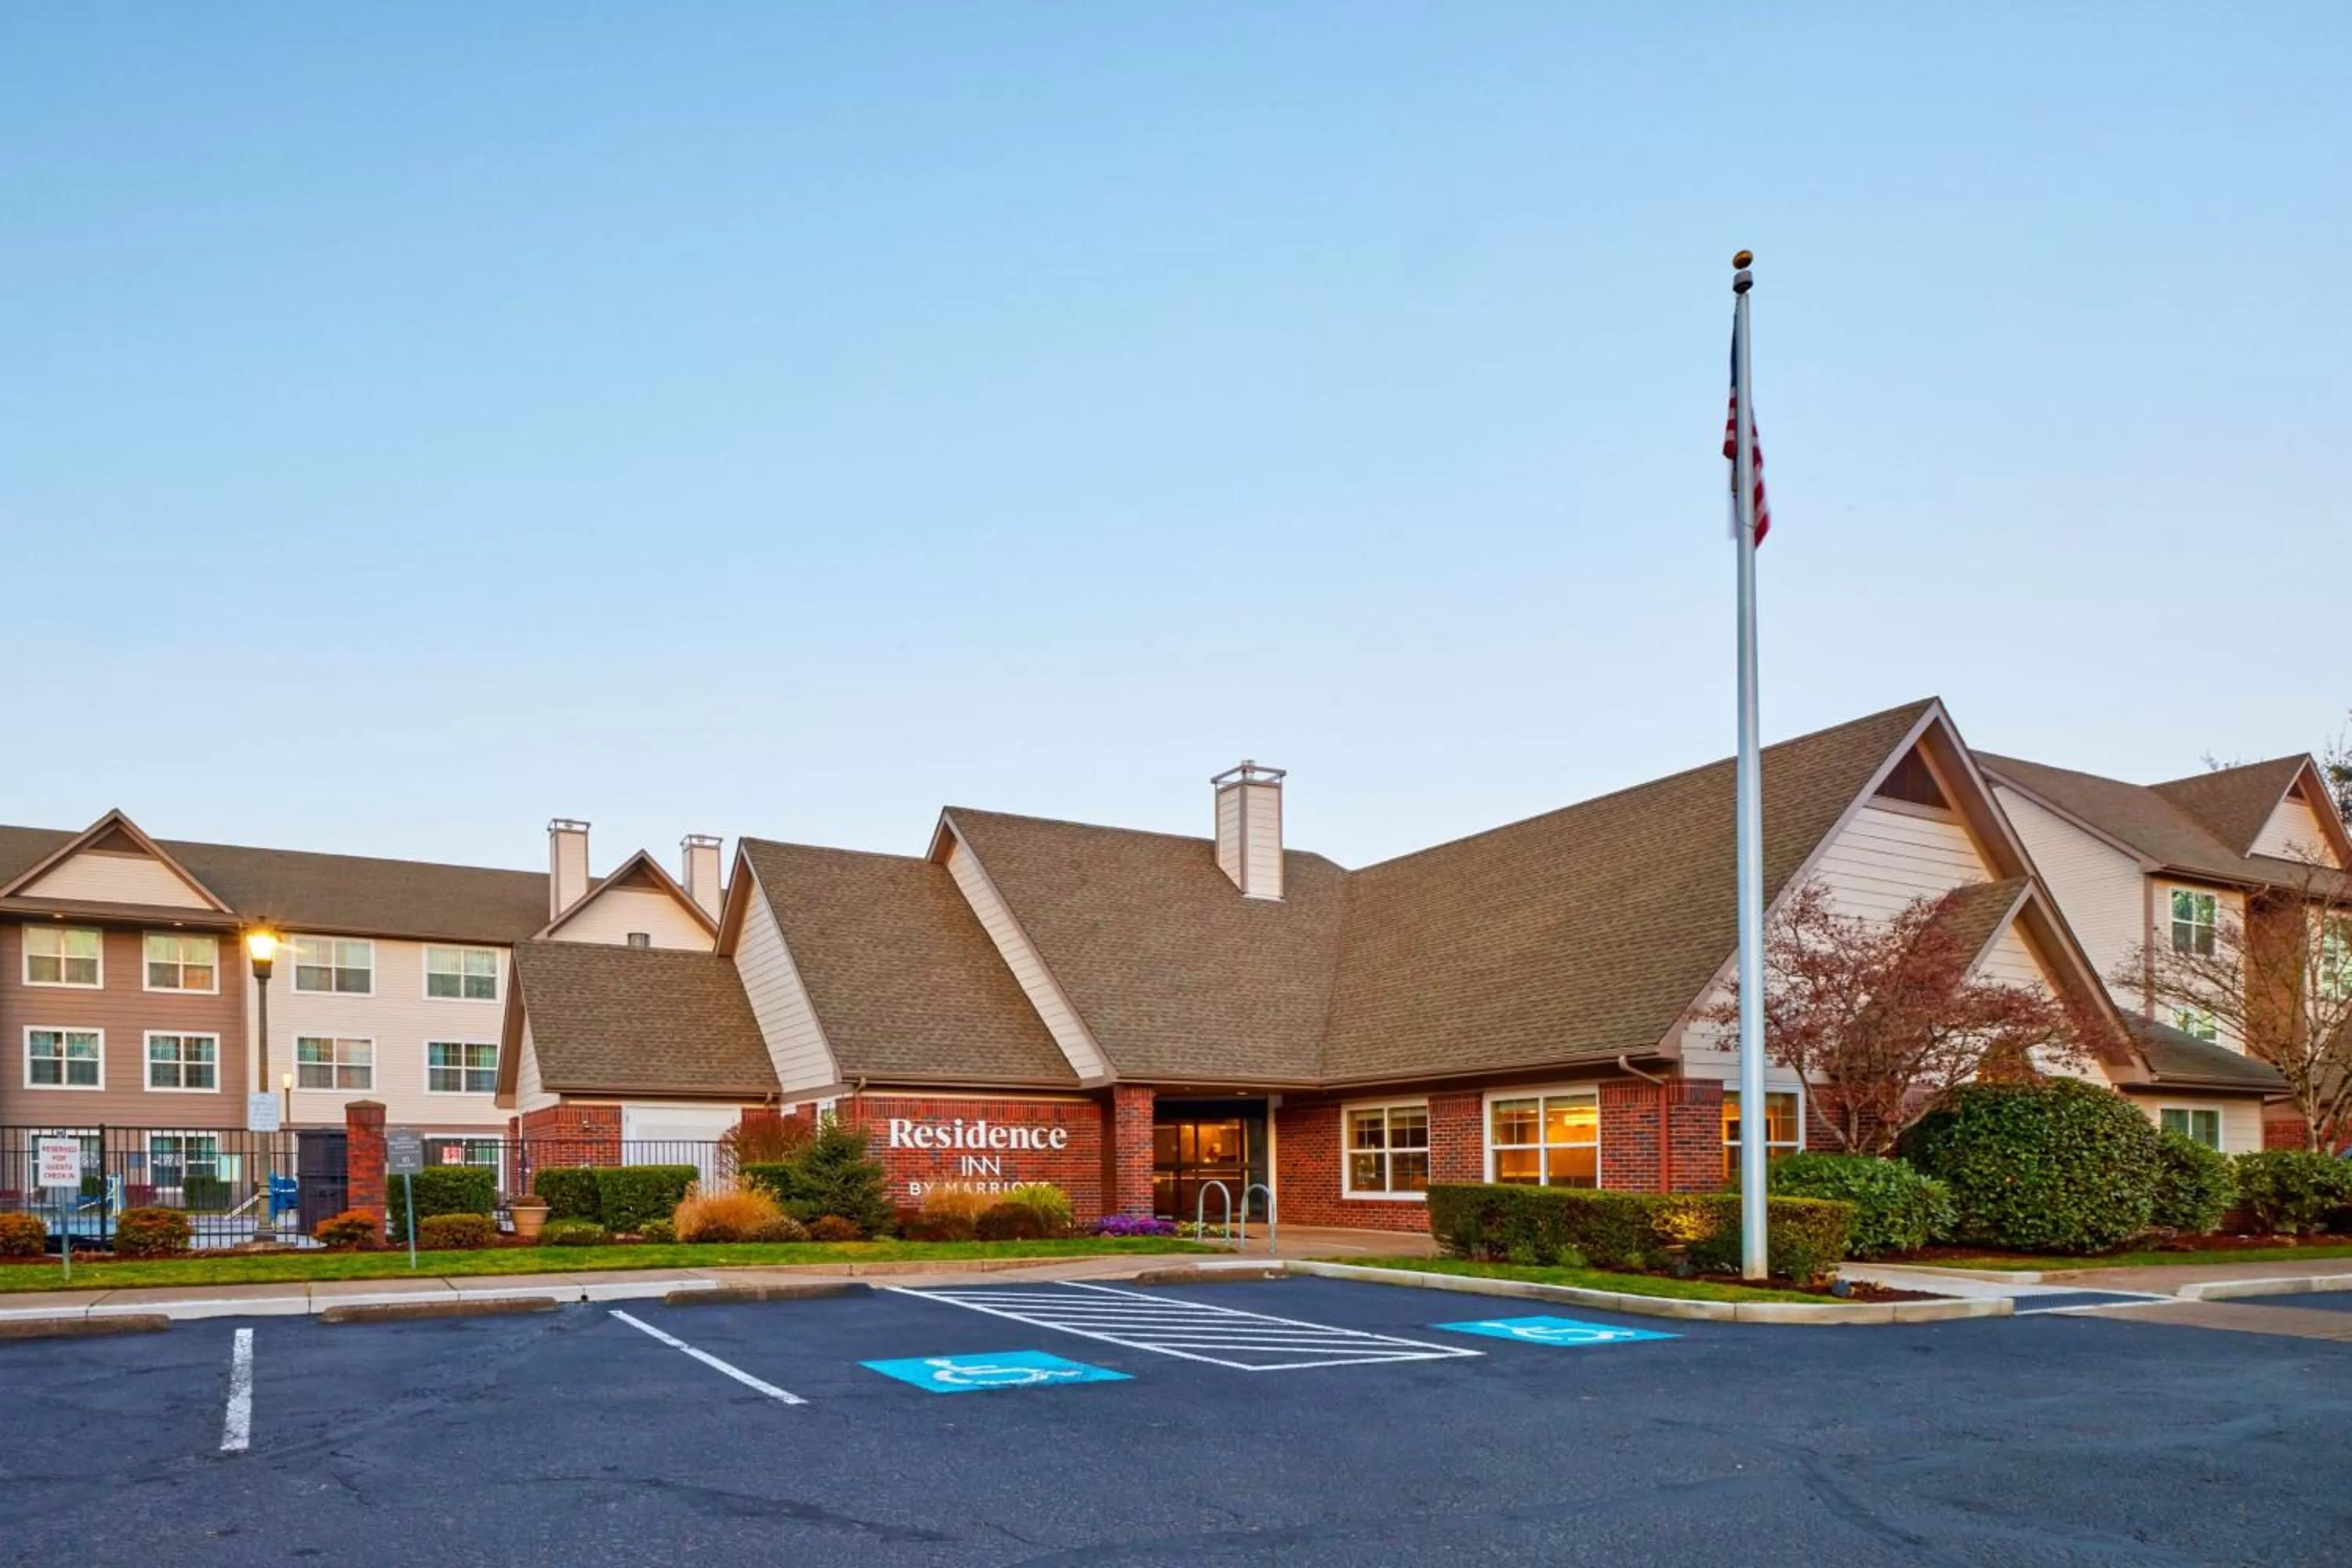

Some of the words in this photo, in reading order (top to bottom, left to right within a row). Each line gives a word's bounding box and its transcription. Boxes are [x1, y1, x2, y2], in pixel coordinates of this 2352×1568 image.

[889, 1118, 1067, 1149] Residence
[961, 1155, 1000, 1176] INN
[909, 1181, 935, 1196] BY
